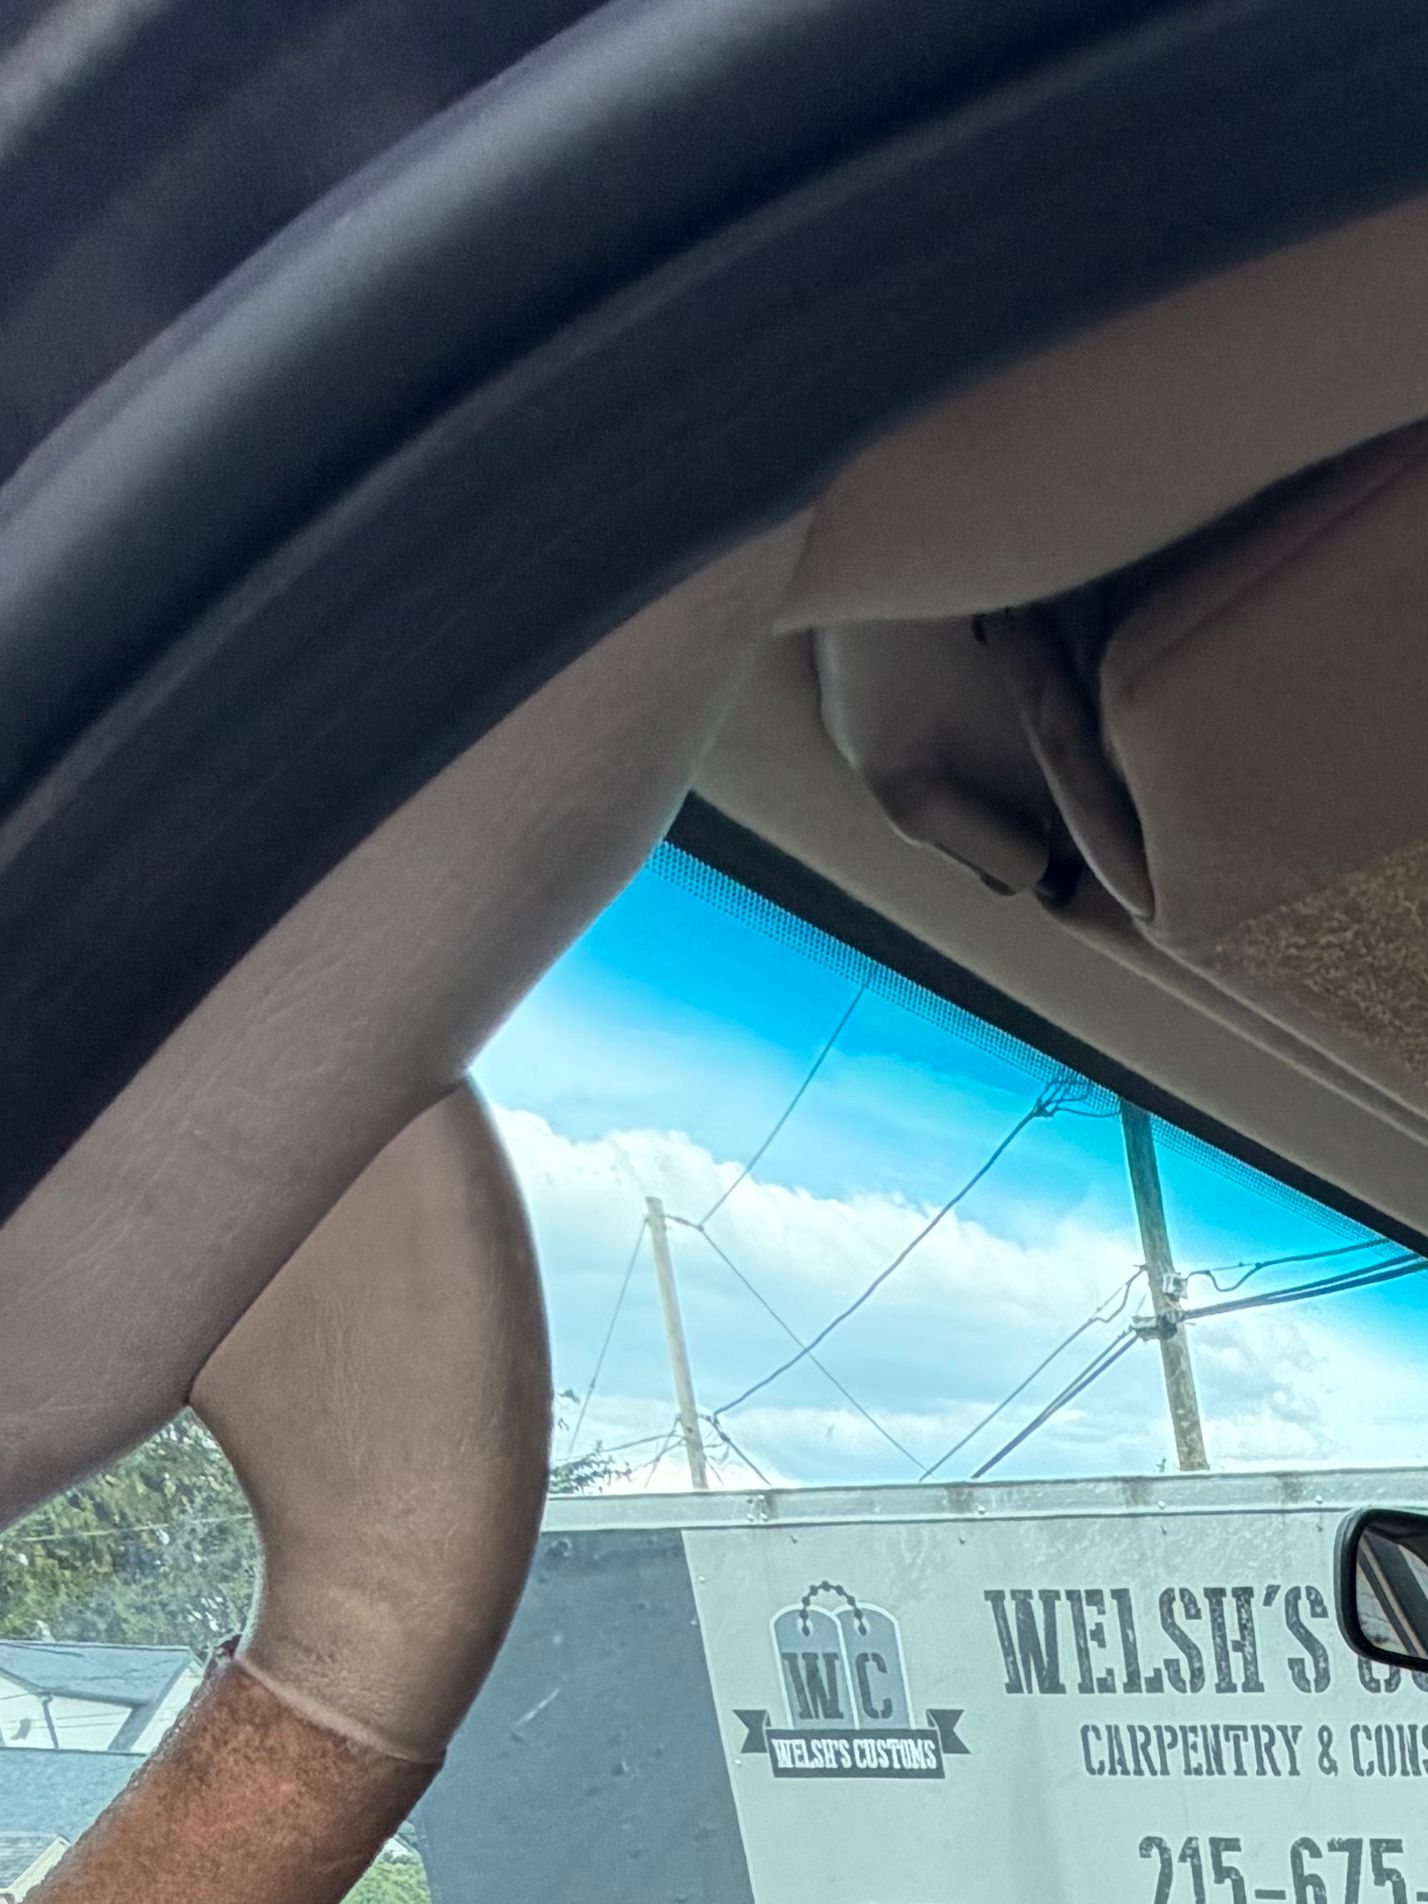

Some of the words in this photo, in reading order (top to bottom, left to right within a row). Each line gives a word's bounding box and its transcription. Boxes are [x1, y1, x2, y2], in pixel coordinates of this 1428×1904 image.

[983, 1584, 1331, 1694] WELSH'S
[772, 1737, 851, 1770] WELSH'S
[852, 1737, 937, 1770] CUSTOMS
[1080, 1723, 1303, 1777] CARPENTRY
[1317, 1724, 1338, 1777] &
